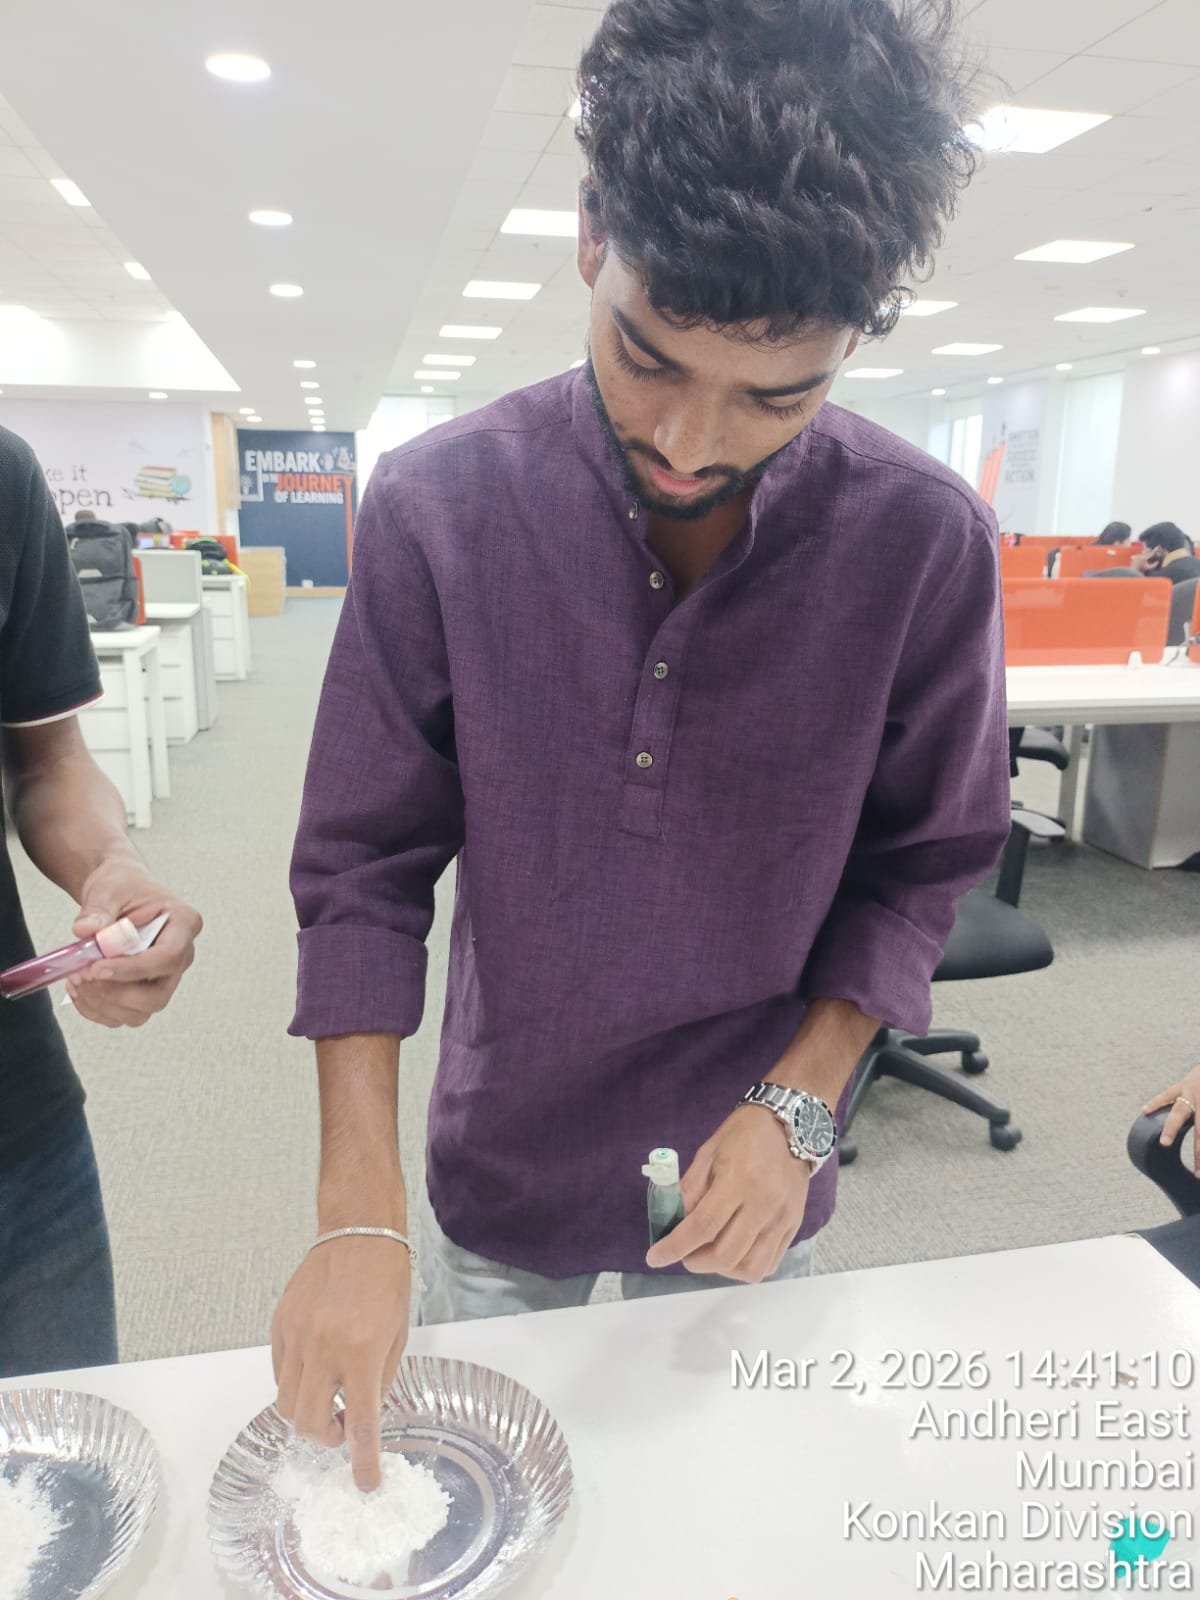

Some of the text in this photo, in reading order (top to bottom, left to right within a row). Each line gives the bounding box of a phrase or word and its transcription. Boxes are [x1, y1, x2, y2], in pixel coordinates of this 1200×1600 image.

[245, 450, 320, 472] EMBARK
[72, 465, 88, 482] it
[276, 473, 353, 493] JOURNEY
[52, 488, 114, 515] pen
[275, 491, 344, 504] OF LEARNING
